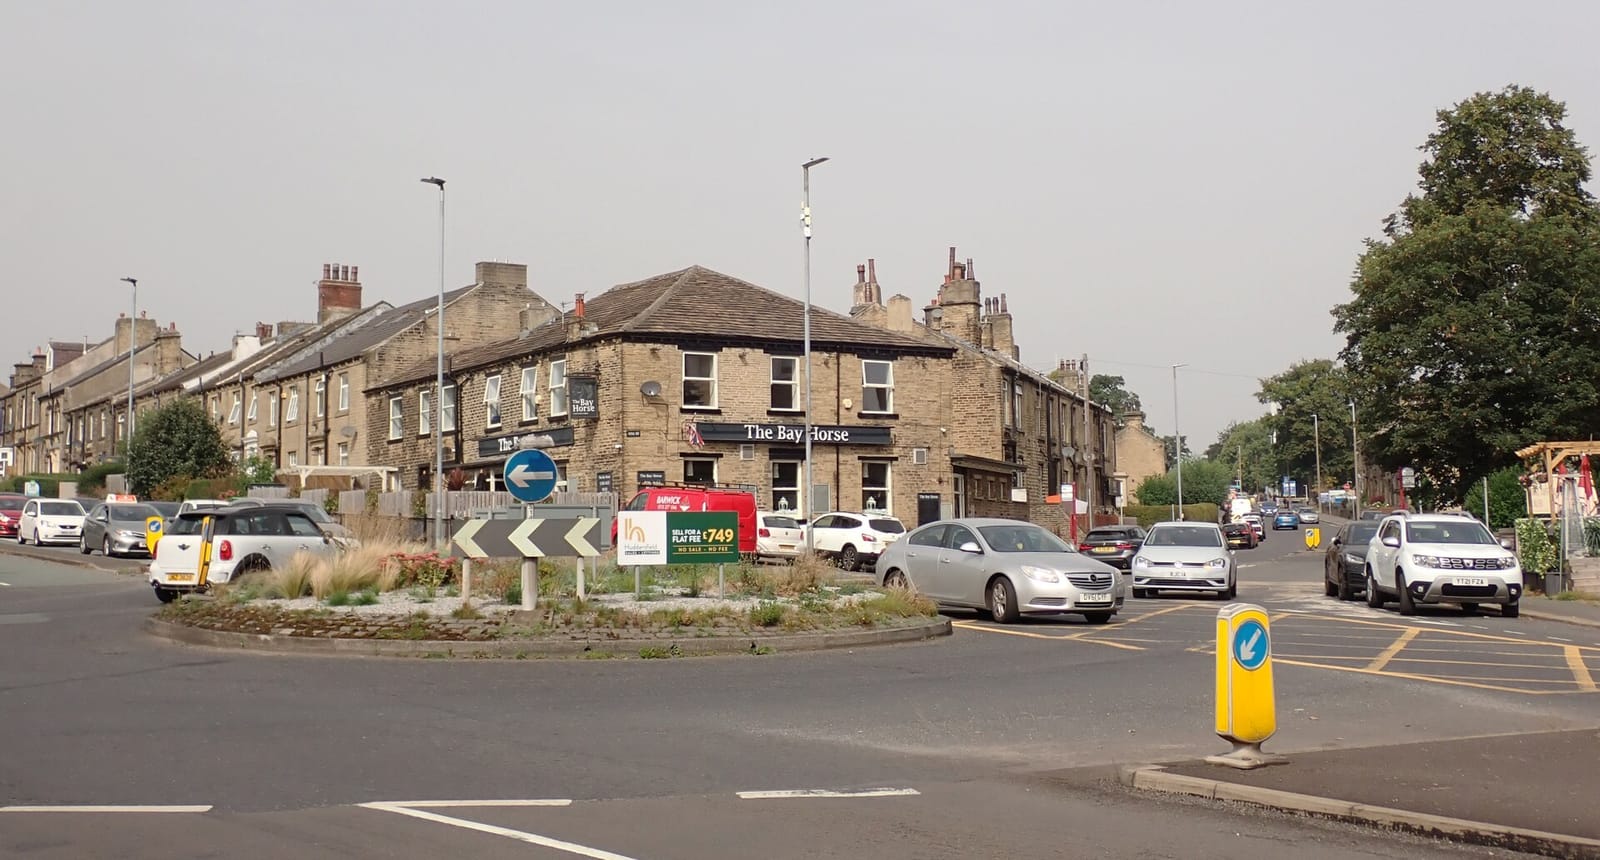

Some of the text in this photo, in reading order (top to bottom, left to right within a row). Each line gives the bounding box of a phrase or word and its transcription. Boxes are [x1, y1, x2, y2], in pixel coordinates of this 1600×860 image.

[580, 398, 594, 407] Bay
[572, 404, 595, 412] Horse
[744, 425, 849, 443] The Bay Horse
[498, 438, 513, 451] The
[656, 496, 681, 505] BARWICK
[689, 535, 702, 543] FEE
[702, 528, 734, 543] £749
